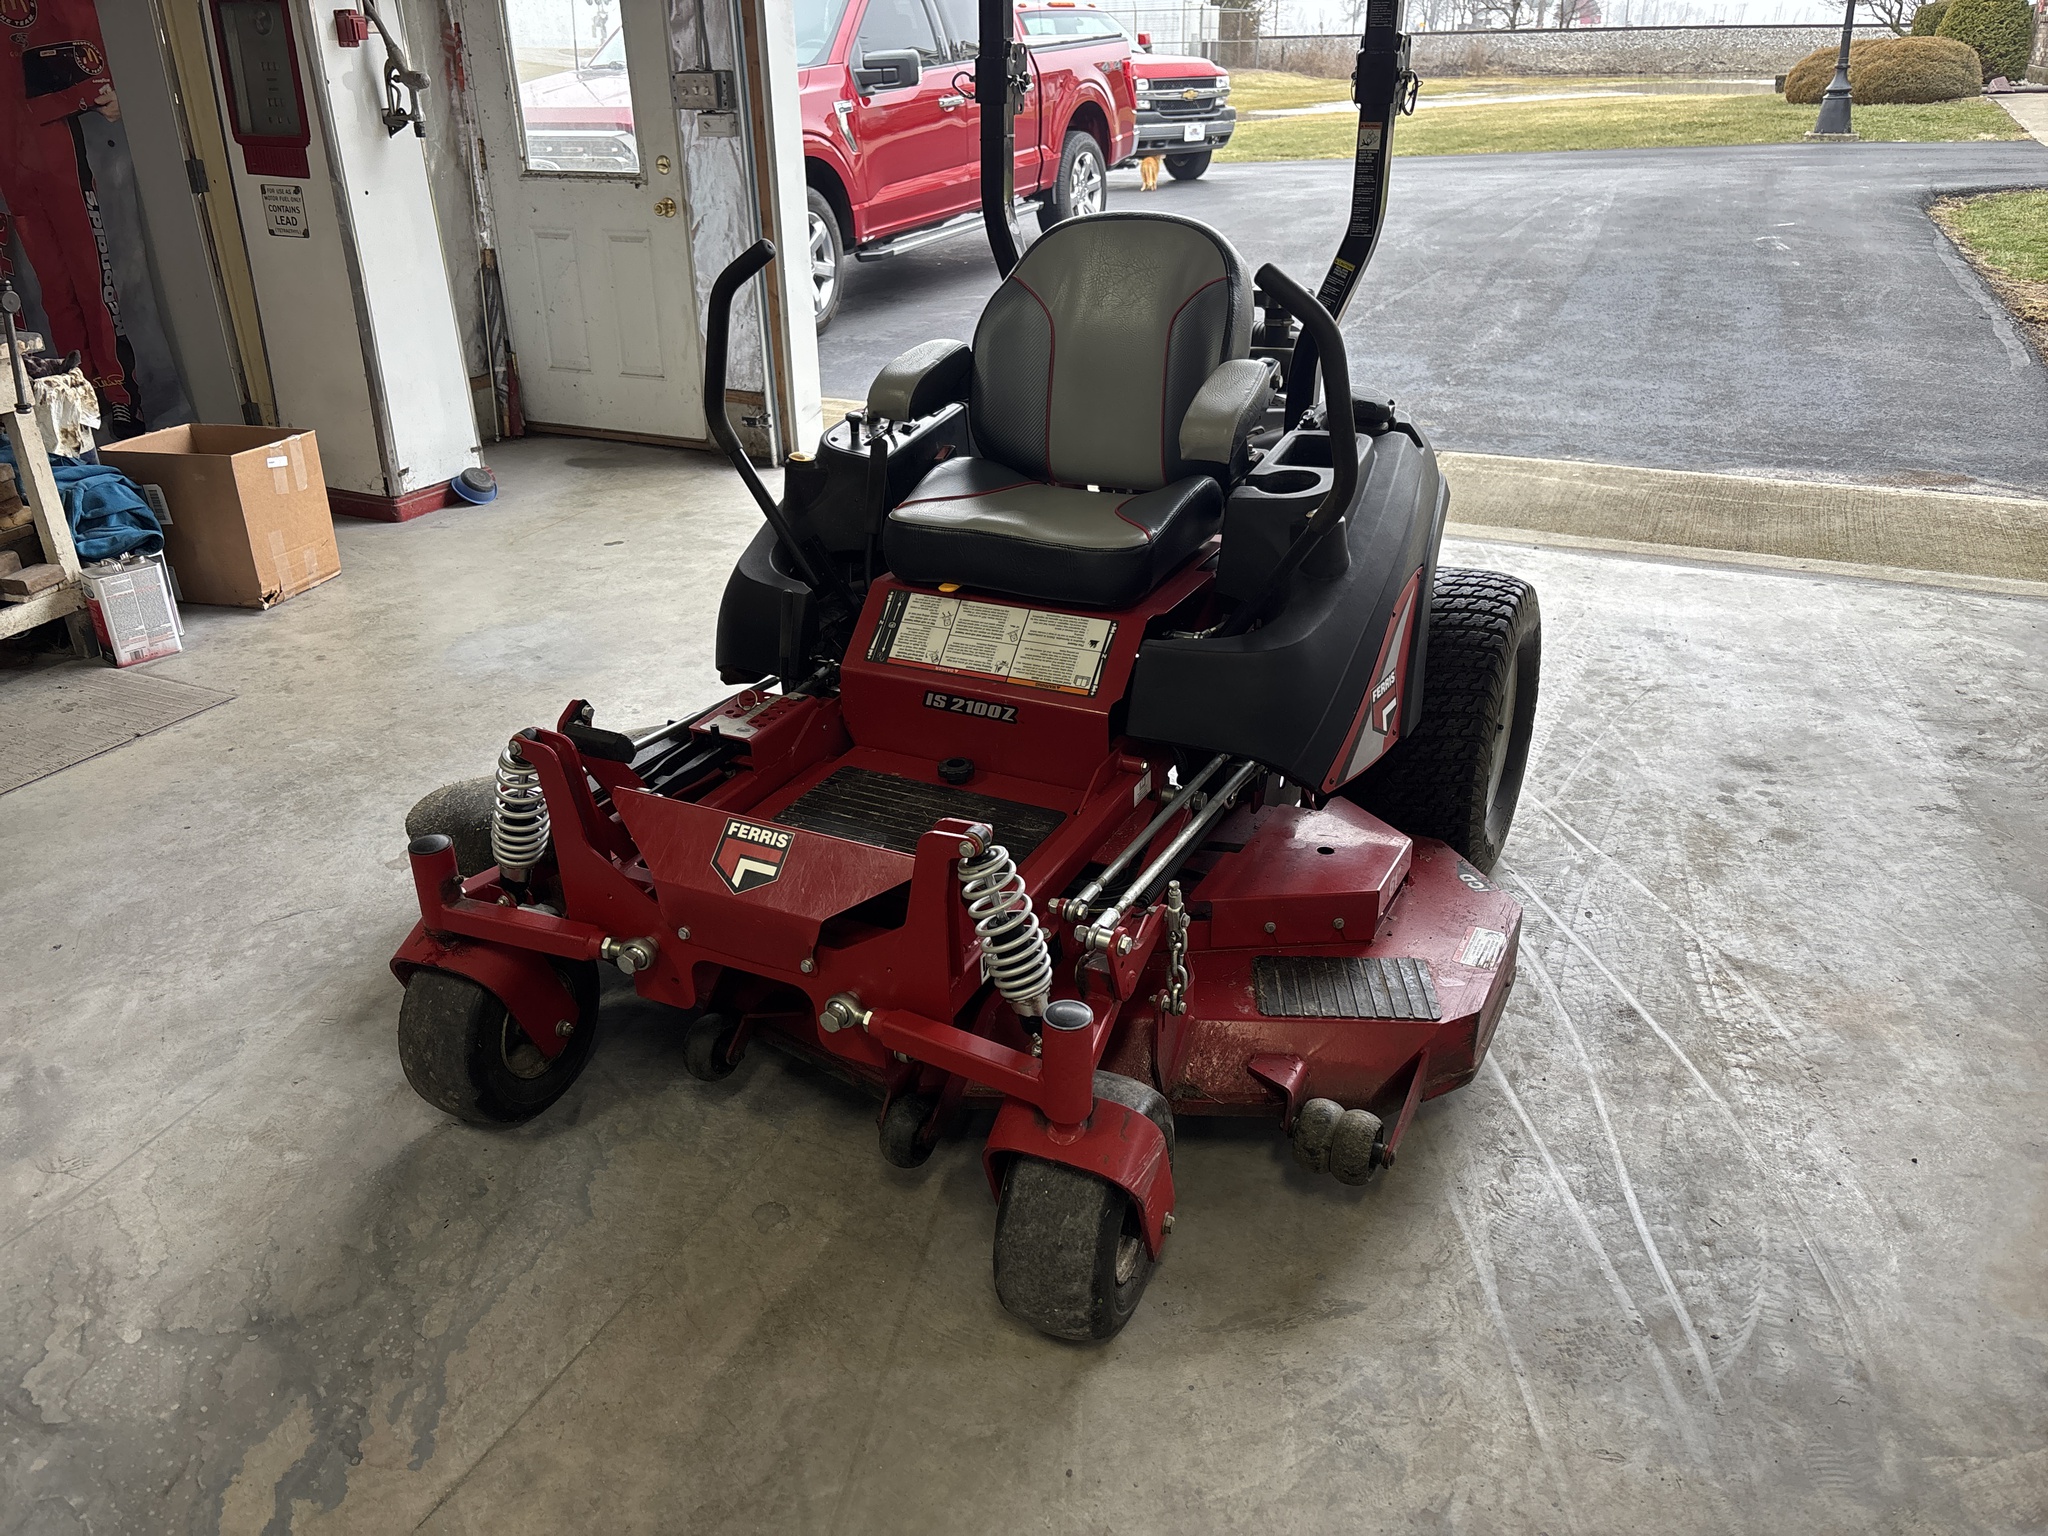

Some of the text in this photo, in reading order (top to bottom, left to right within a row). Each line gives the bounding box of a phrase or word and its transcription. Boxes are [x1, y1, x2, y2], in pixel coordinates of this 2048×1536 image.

[14, 14, 35, 26] TEAM
[268, 204, 301, 214] CONTAINS
[274, 215, 298, 226] LEAD
[84, 190, 127, 337] McDonald's
[1372, 672, 1396, 704] FERRIS
[925, 692, 1016, 722] IS 2100Z
[727, 821, 789, 848] FERRIS
